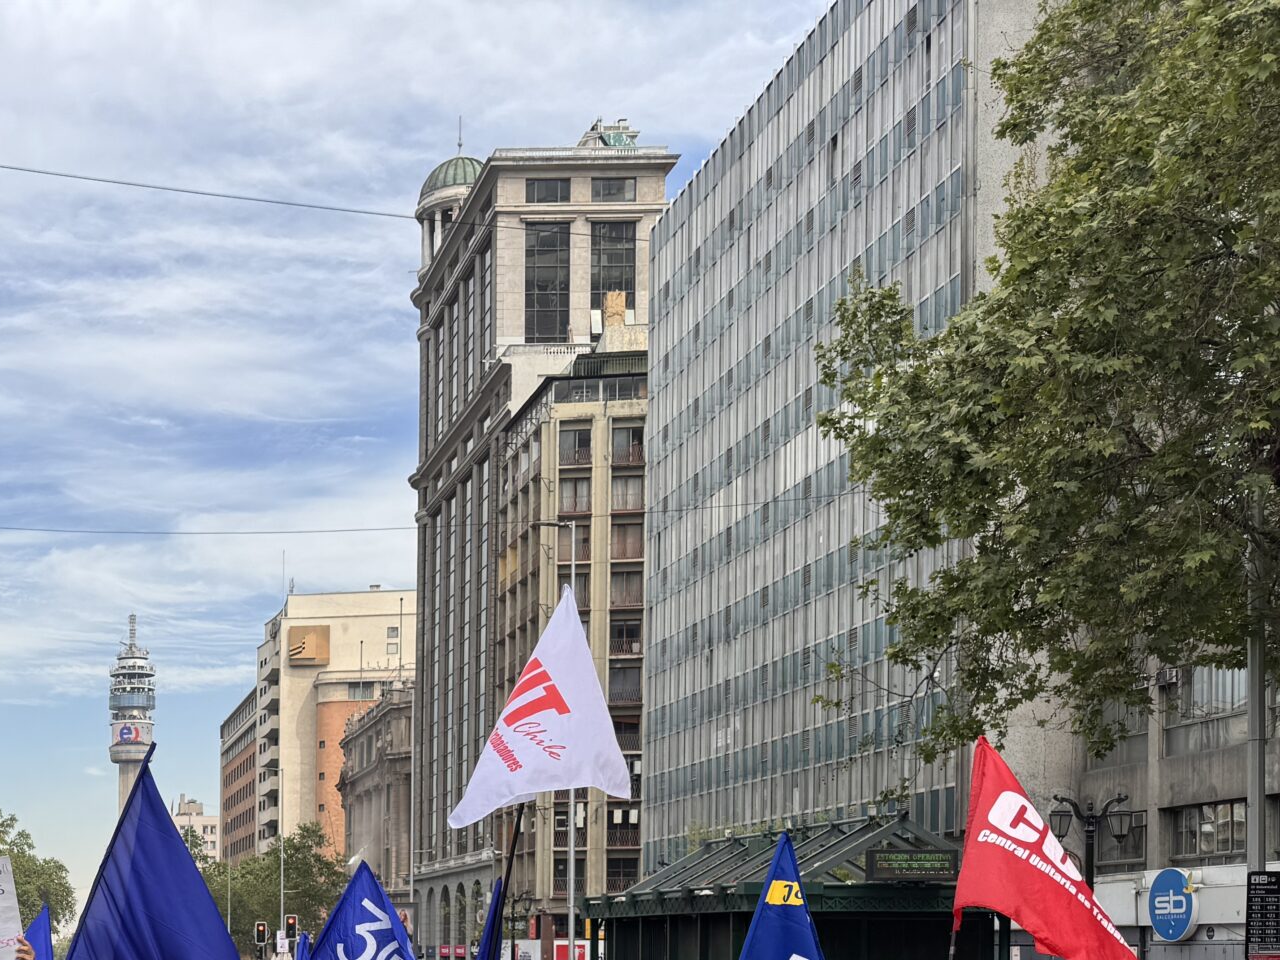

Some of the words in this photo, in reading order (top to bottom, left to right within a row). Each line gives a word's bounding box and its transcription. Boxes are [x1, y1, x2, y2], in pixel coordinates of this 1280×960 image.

[513, 721, 567, 761] Chile
[977, 829, 1030, 860] Central
[1029, 853, 1077, 896] Unitaria
[1076, 892, 1091, 911] de
[1154, 889, 1186, 914] sb
